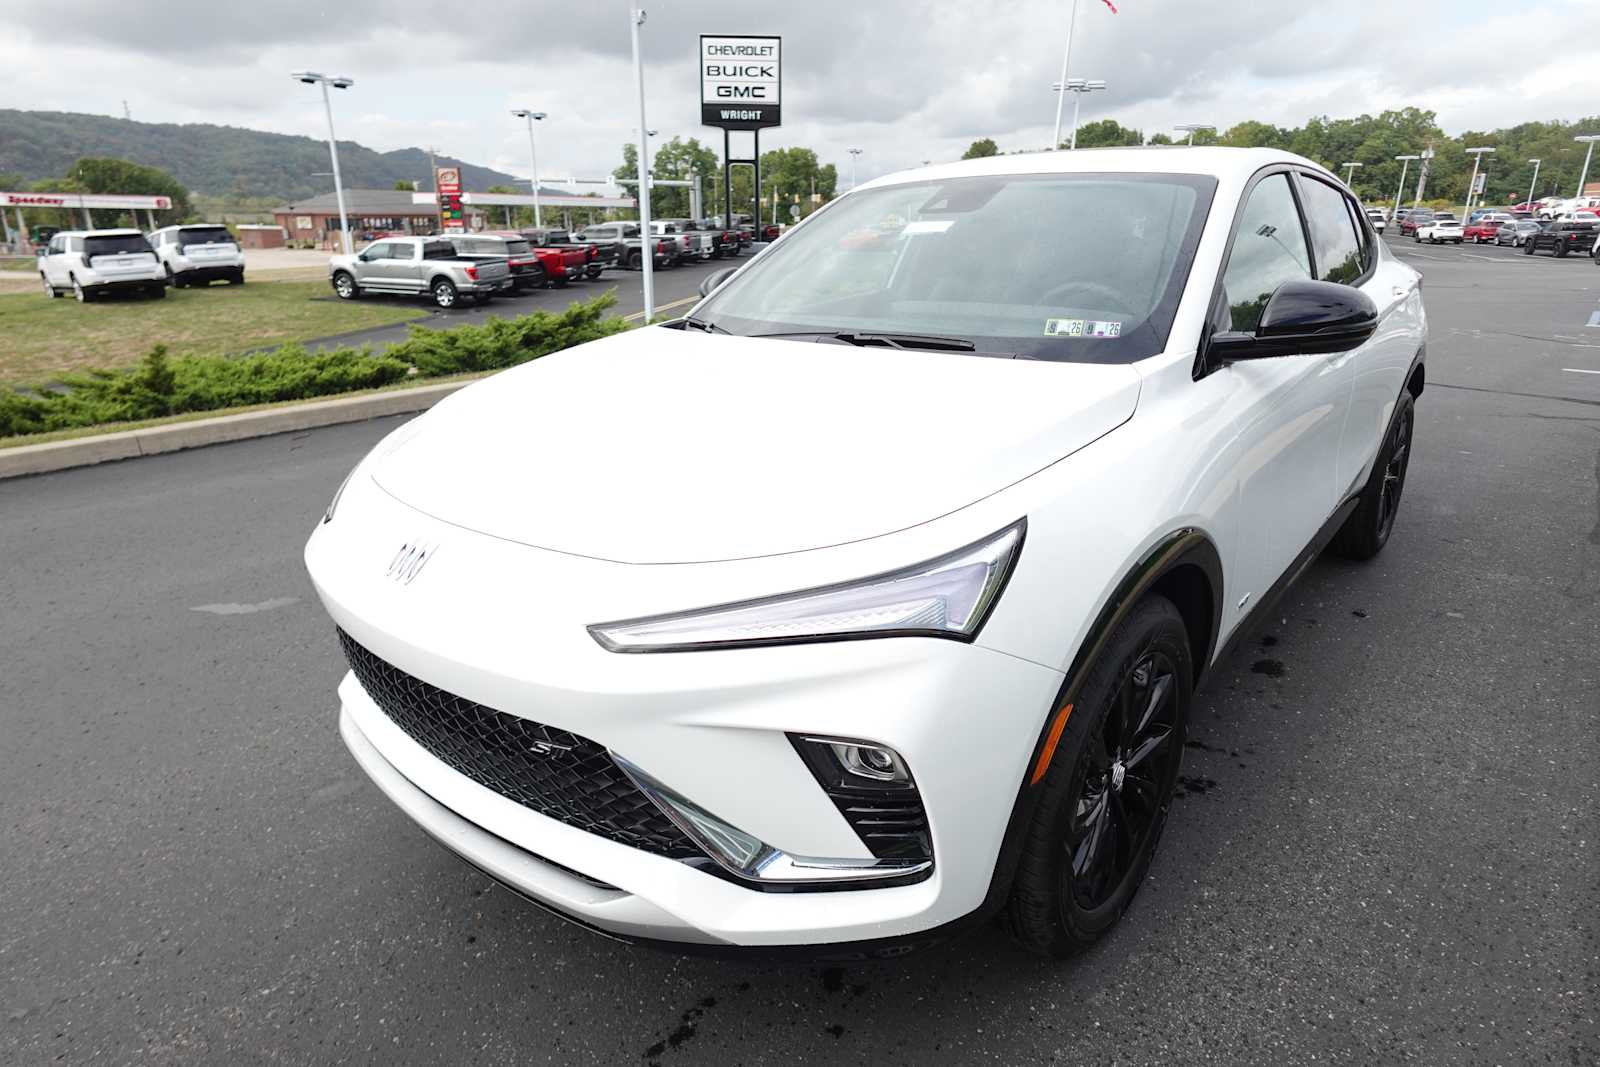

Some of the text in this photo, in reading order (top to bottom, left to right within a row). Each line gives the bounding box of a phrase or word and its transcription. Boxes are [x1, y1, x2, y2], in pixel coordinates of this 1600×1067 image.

[707, 45, 774, 56] CHEVROLET
[706, 65, 775, 78] BUICK
[717, 86, 766, 98] GMC
[720, 109, 762, 120] WRIGHT
[1109, 323, 1120, 336] 26
